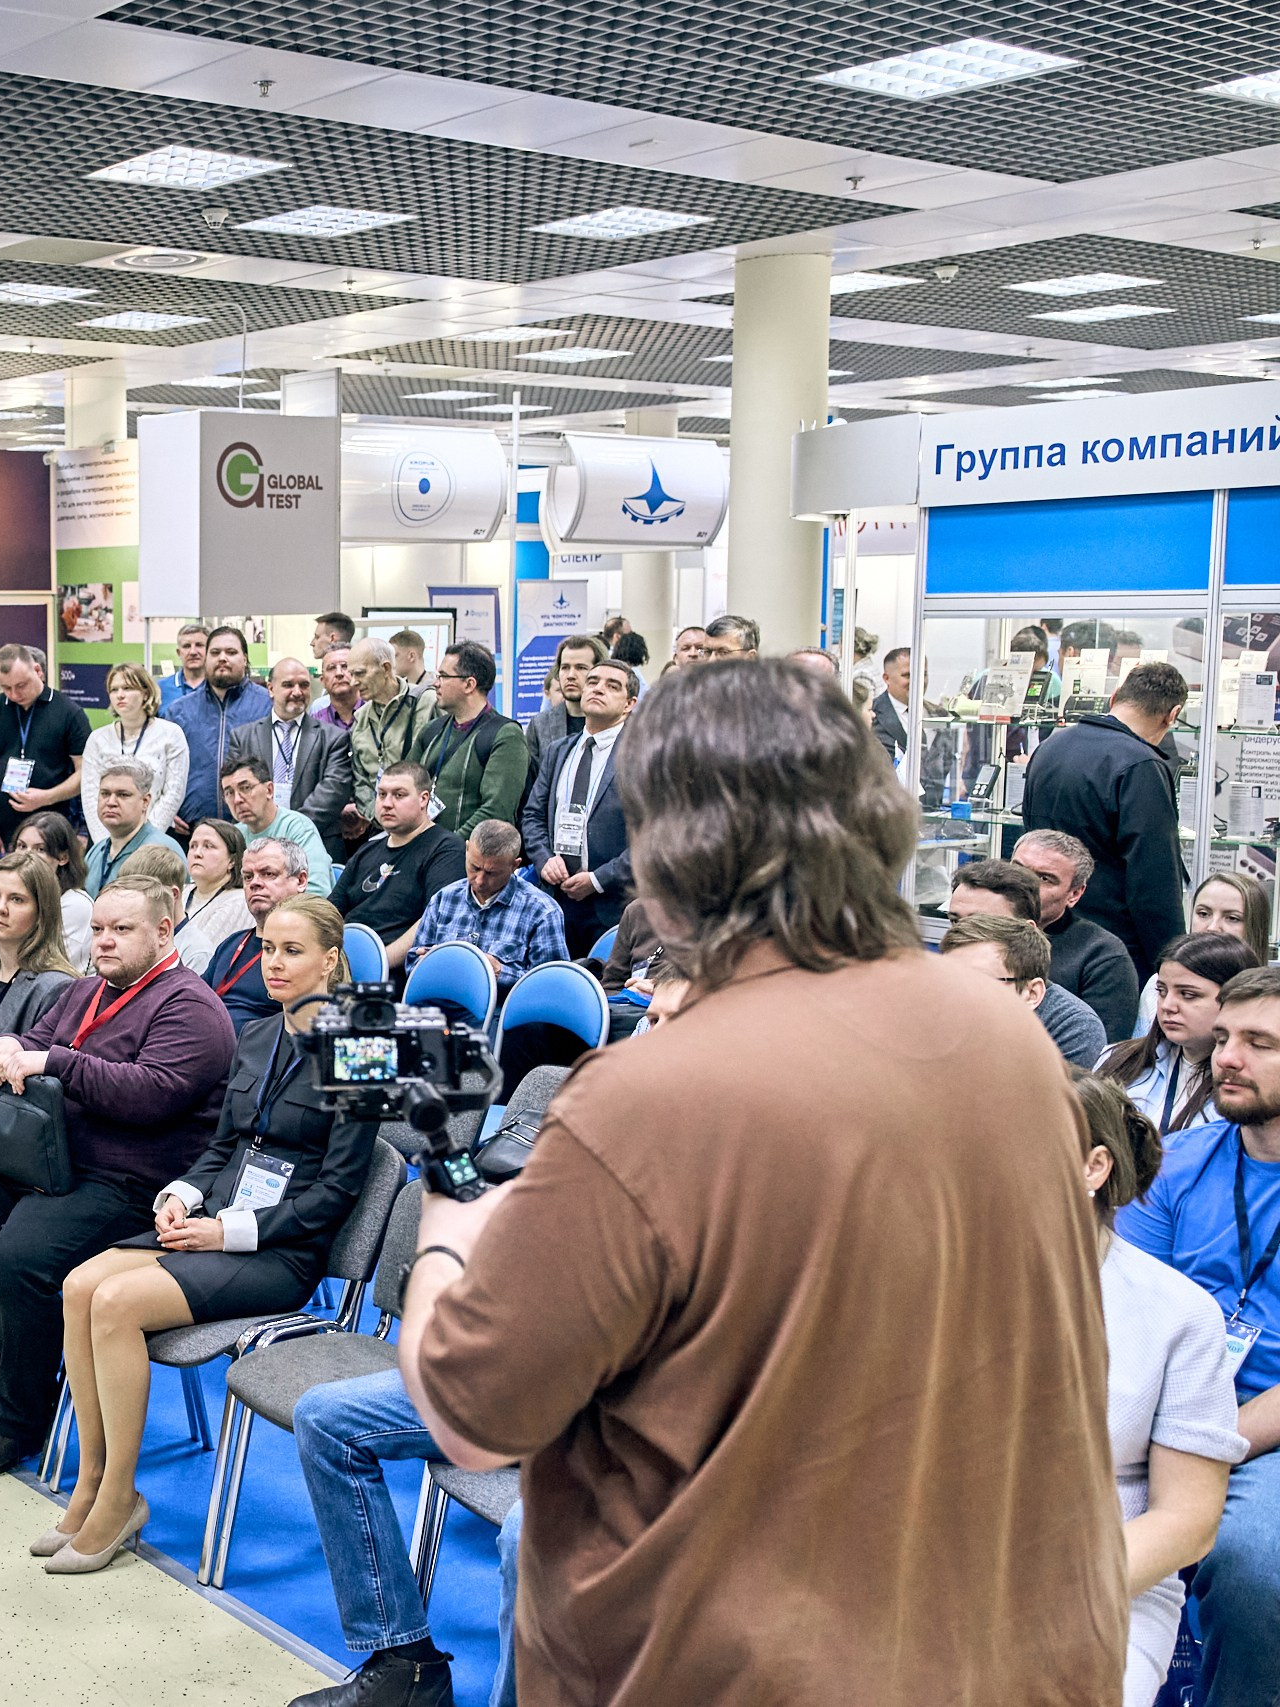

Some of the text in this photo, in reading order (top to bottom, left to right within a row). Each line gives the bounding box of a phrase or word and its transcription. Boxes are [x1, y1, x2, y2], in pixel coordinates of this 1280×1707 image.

[935, 441, 1066, 482] Группа
[267, 474, 323, 490] GLOBAL
[267, 494, 301, 509] TEST
